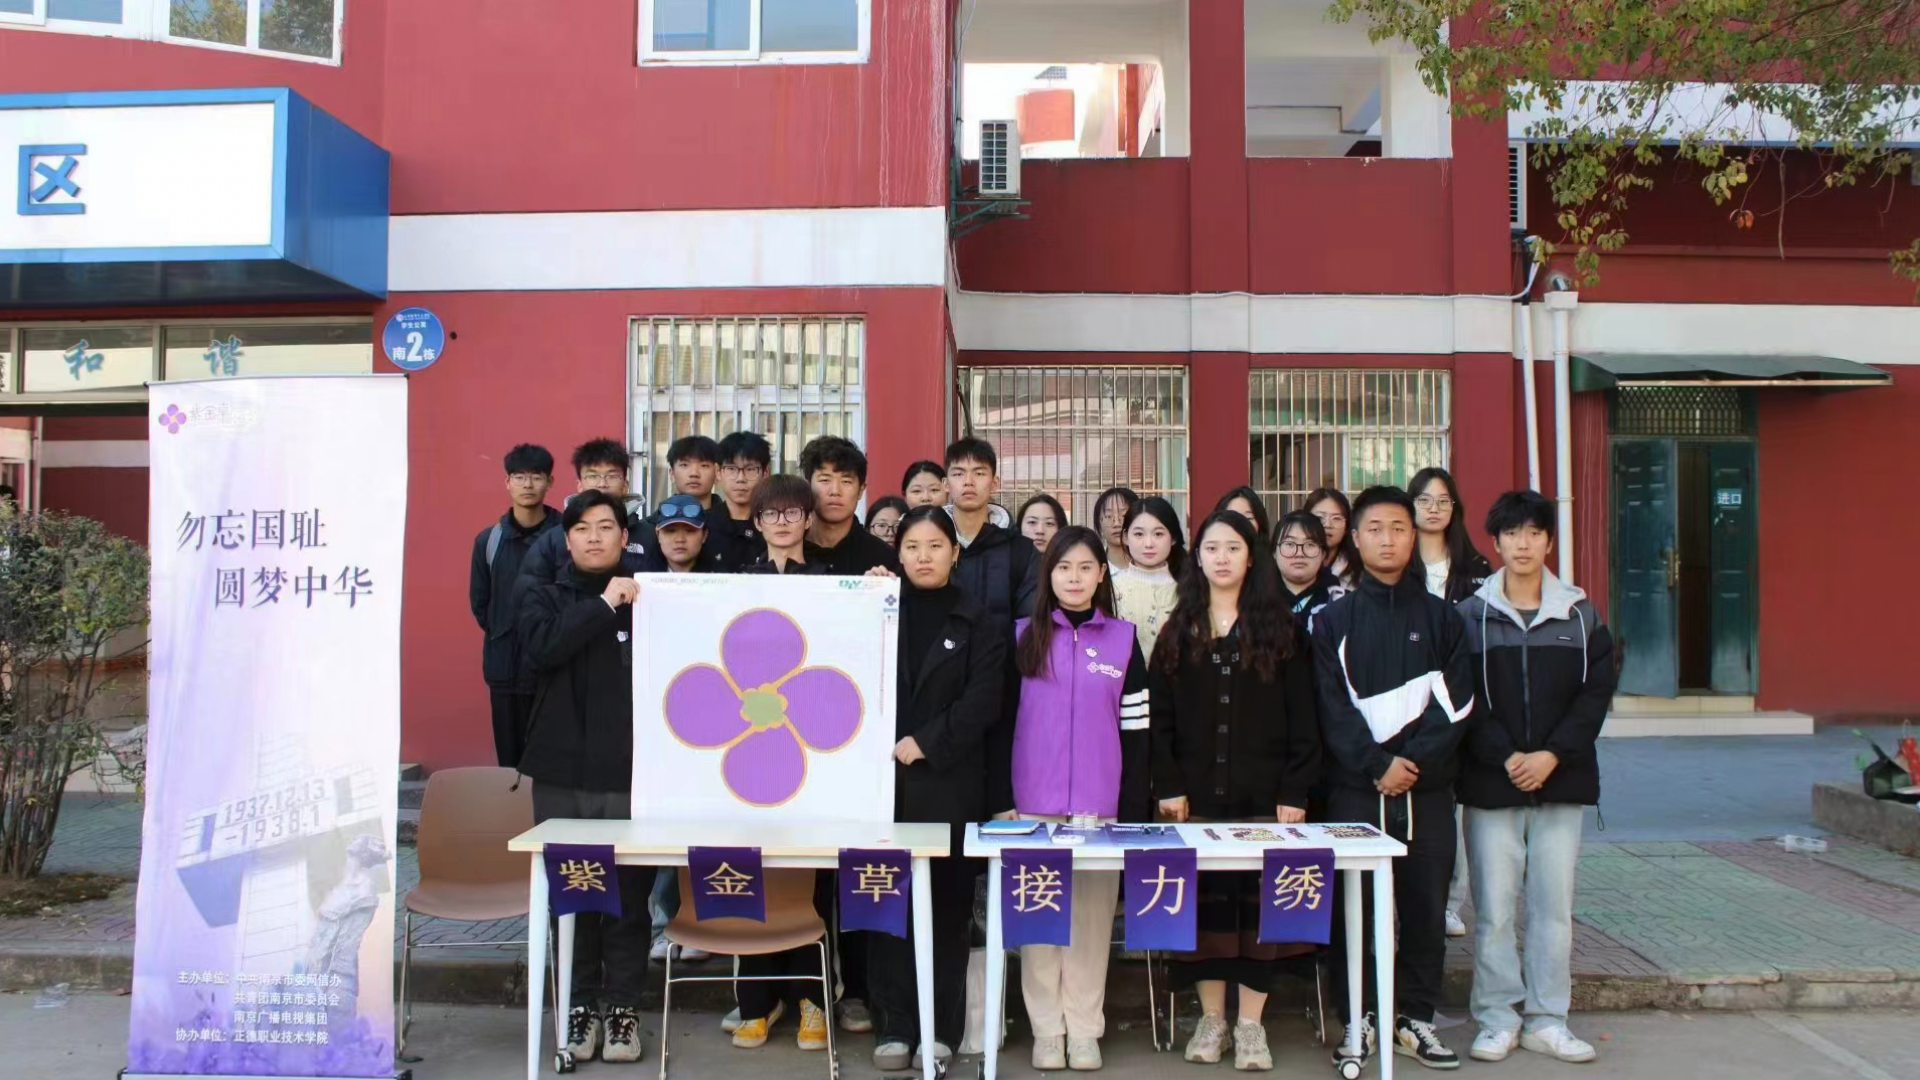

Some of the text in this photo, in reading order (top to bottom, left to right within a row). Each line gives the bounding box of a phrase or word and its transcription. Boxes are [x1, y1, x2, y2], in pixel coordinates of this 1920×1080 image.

[17, 143, 88, 215] 区
[63, 335, 244, 380] 和 谐
[1717, 492, 1742, 505] 进口
[176, 508, 328, 552] 勿忘国耻
[215, 566, 374, 609] 圆梦中华
[558, 859, 607, 892] 紫
[702, 861, 755, 896] 金
[851, 863, 901, 902] 草
[1011, 864, 1063, 912] 接
[1136, 864, 1186, 916] 力
[1273, 864, 1326, 911] 绣
[233, 1010, 328, 1025] 南京广播电视集团
